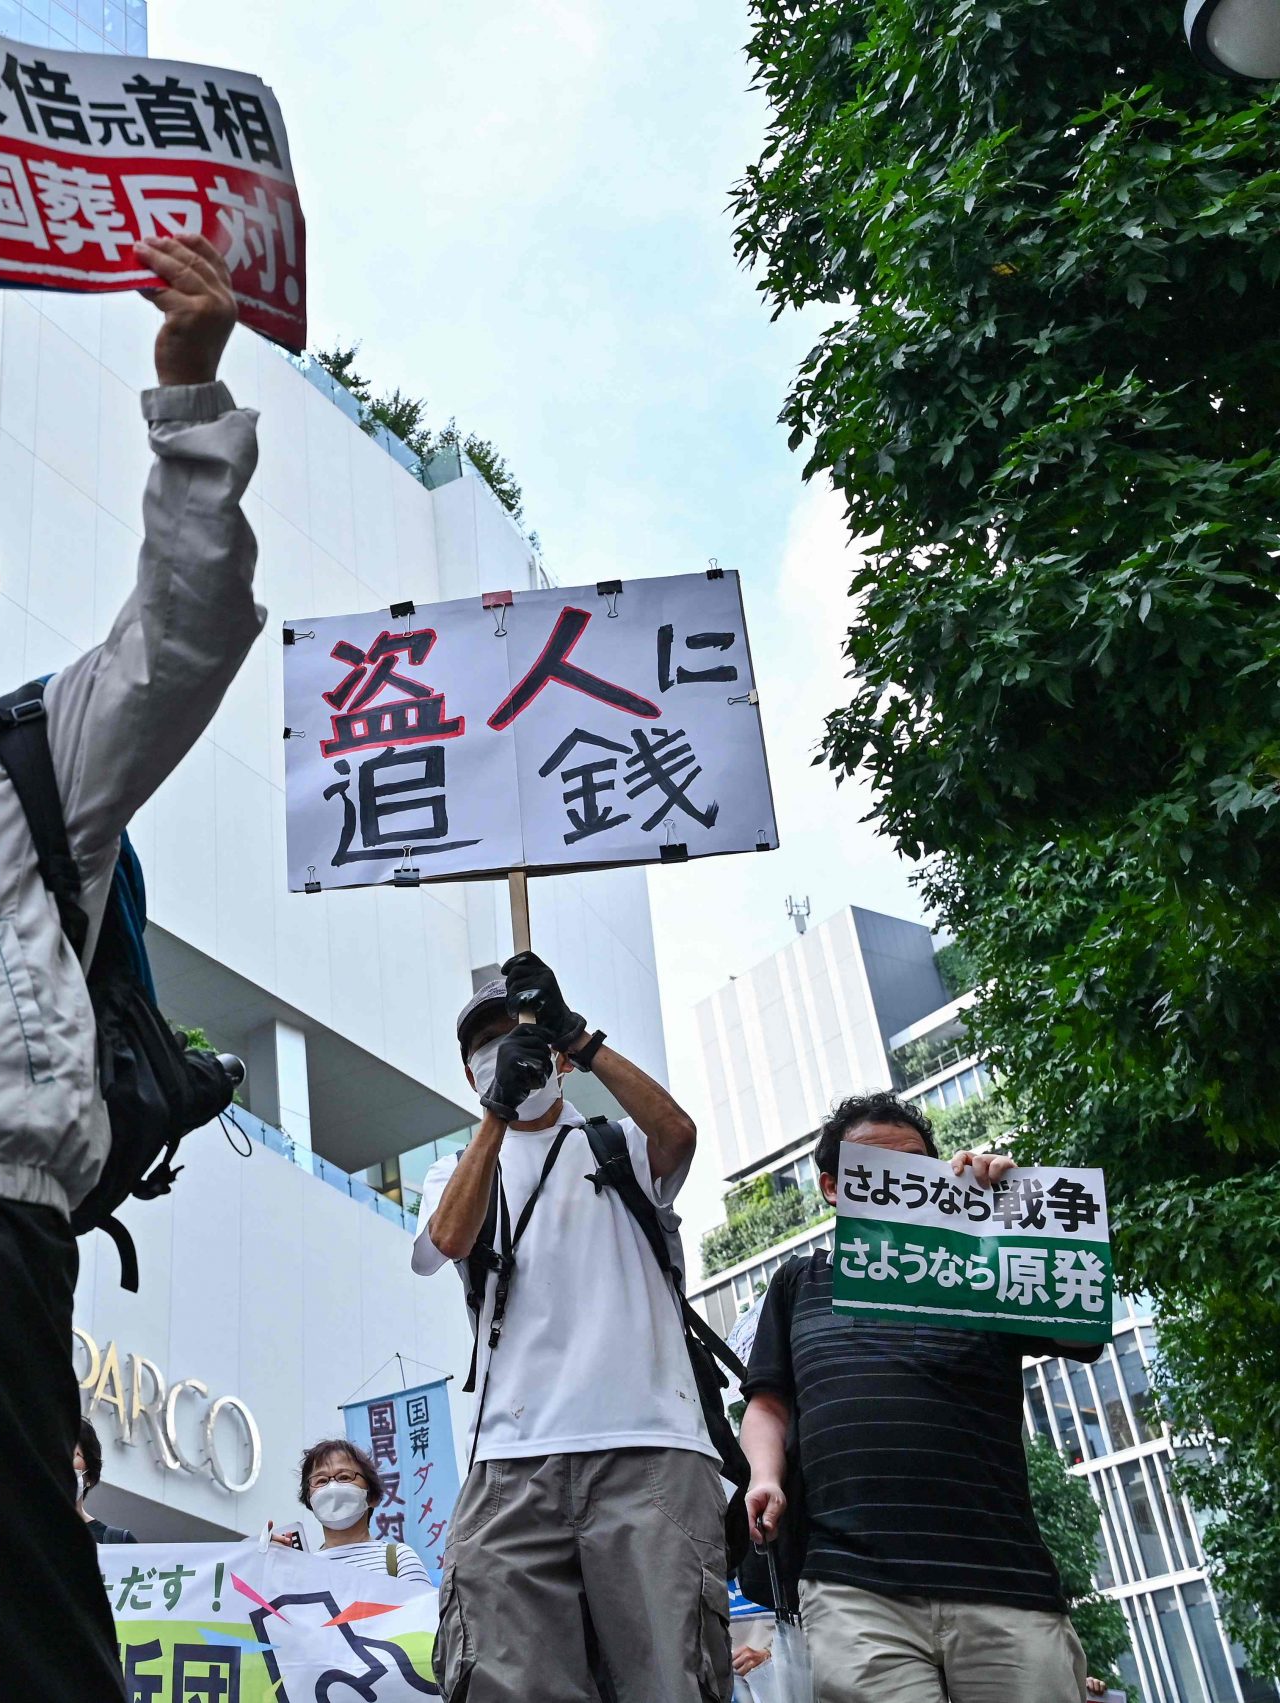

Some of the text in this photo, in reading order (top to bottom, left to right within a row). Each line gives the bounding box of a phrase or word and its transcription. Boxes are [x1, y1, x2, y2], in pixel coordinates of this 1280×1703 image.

[320, 606, 738, 757] 盗人に
[323, 728, 719, 866] 追銭
[843, 1164, 1100, 1233] さようなら戦争
[840, 1237, 1106, 1313] さようなら原発
[367, 1401, 406, 1544] 国民反対
